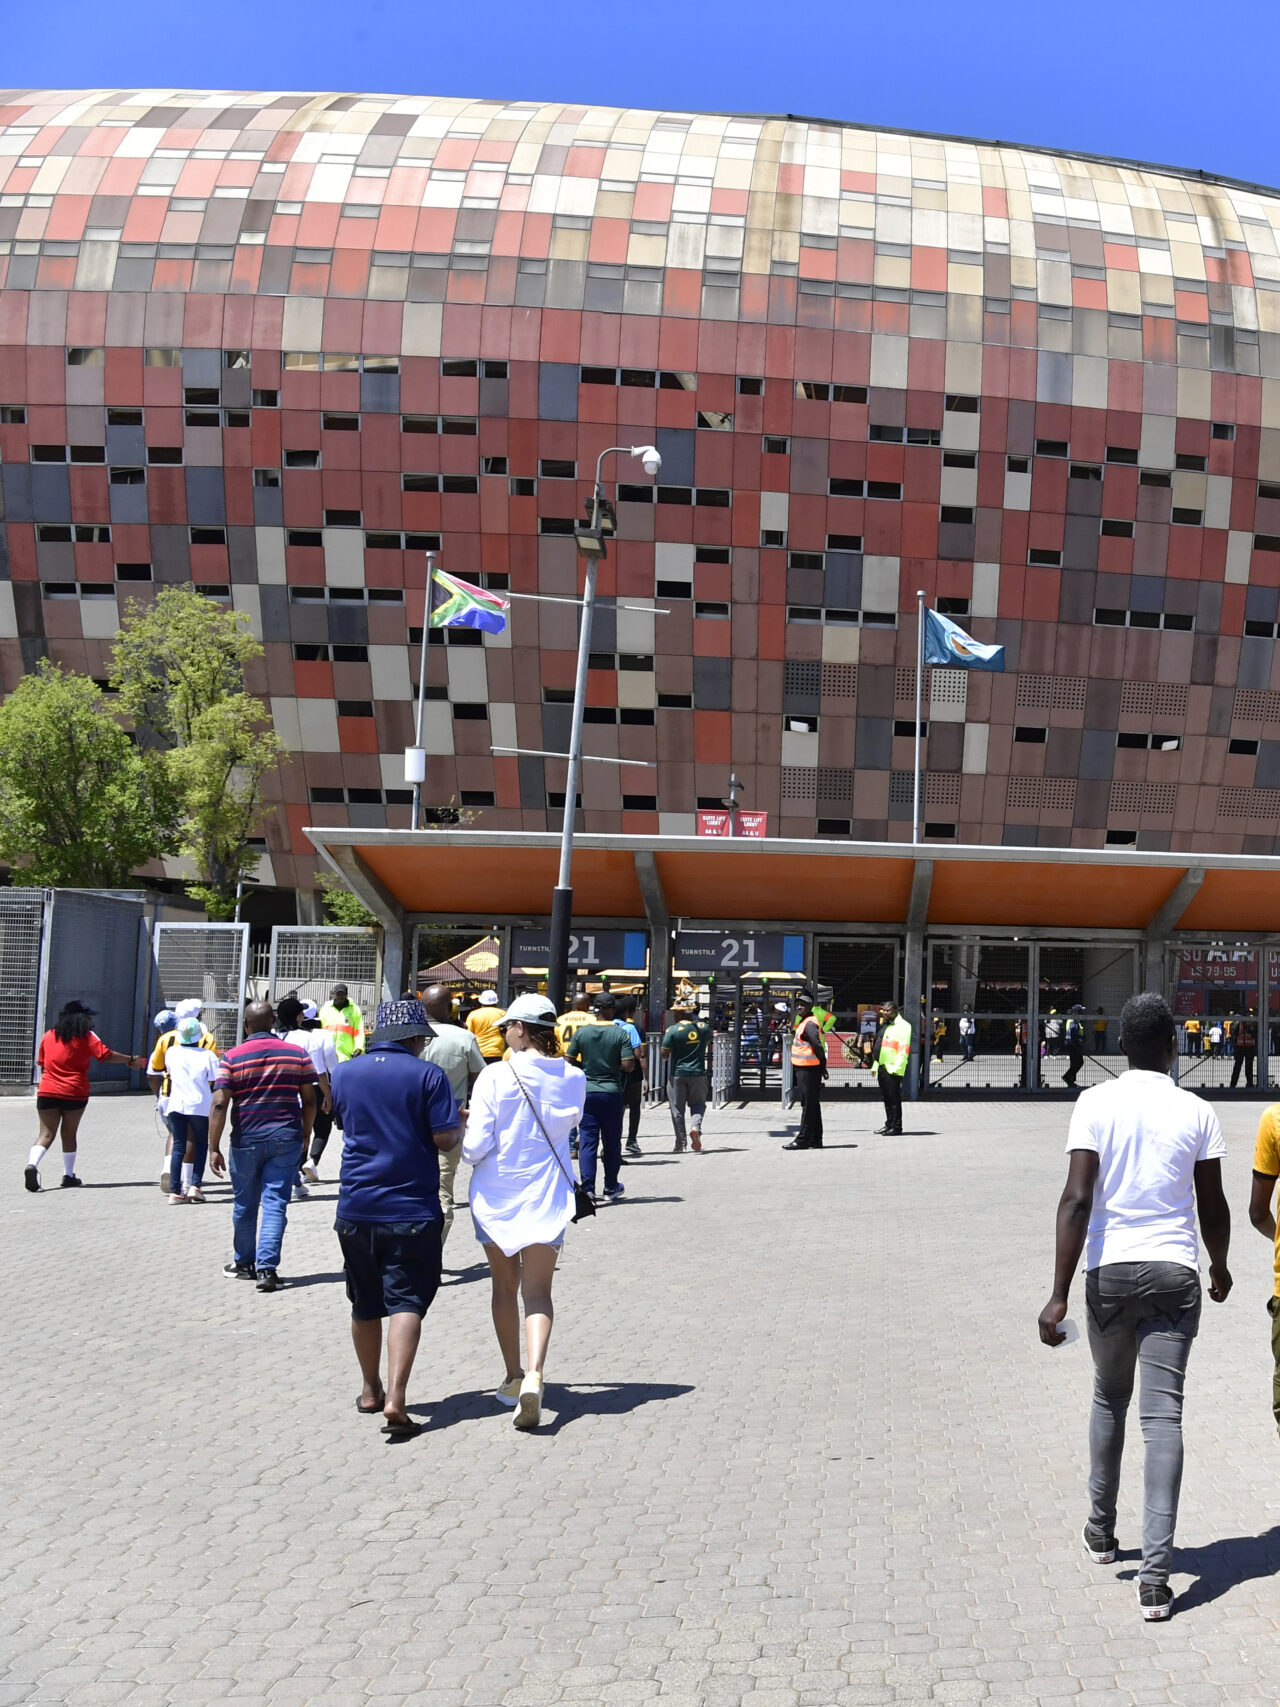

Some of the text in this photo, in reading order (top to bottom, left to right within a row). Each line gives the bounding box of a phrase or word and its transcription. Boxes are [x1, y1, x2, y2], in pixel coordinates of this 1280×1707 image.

[568, 935, 600, 964] 21
[720, 938, 760, 967] 21
[467, 980, 497, 990] Chiefs
